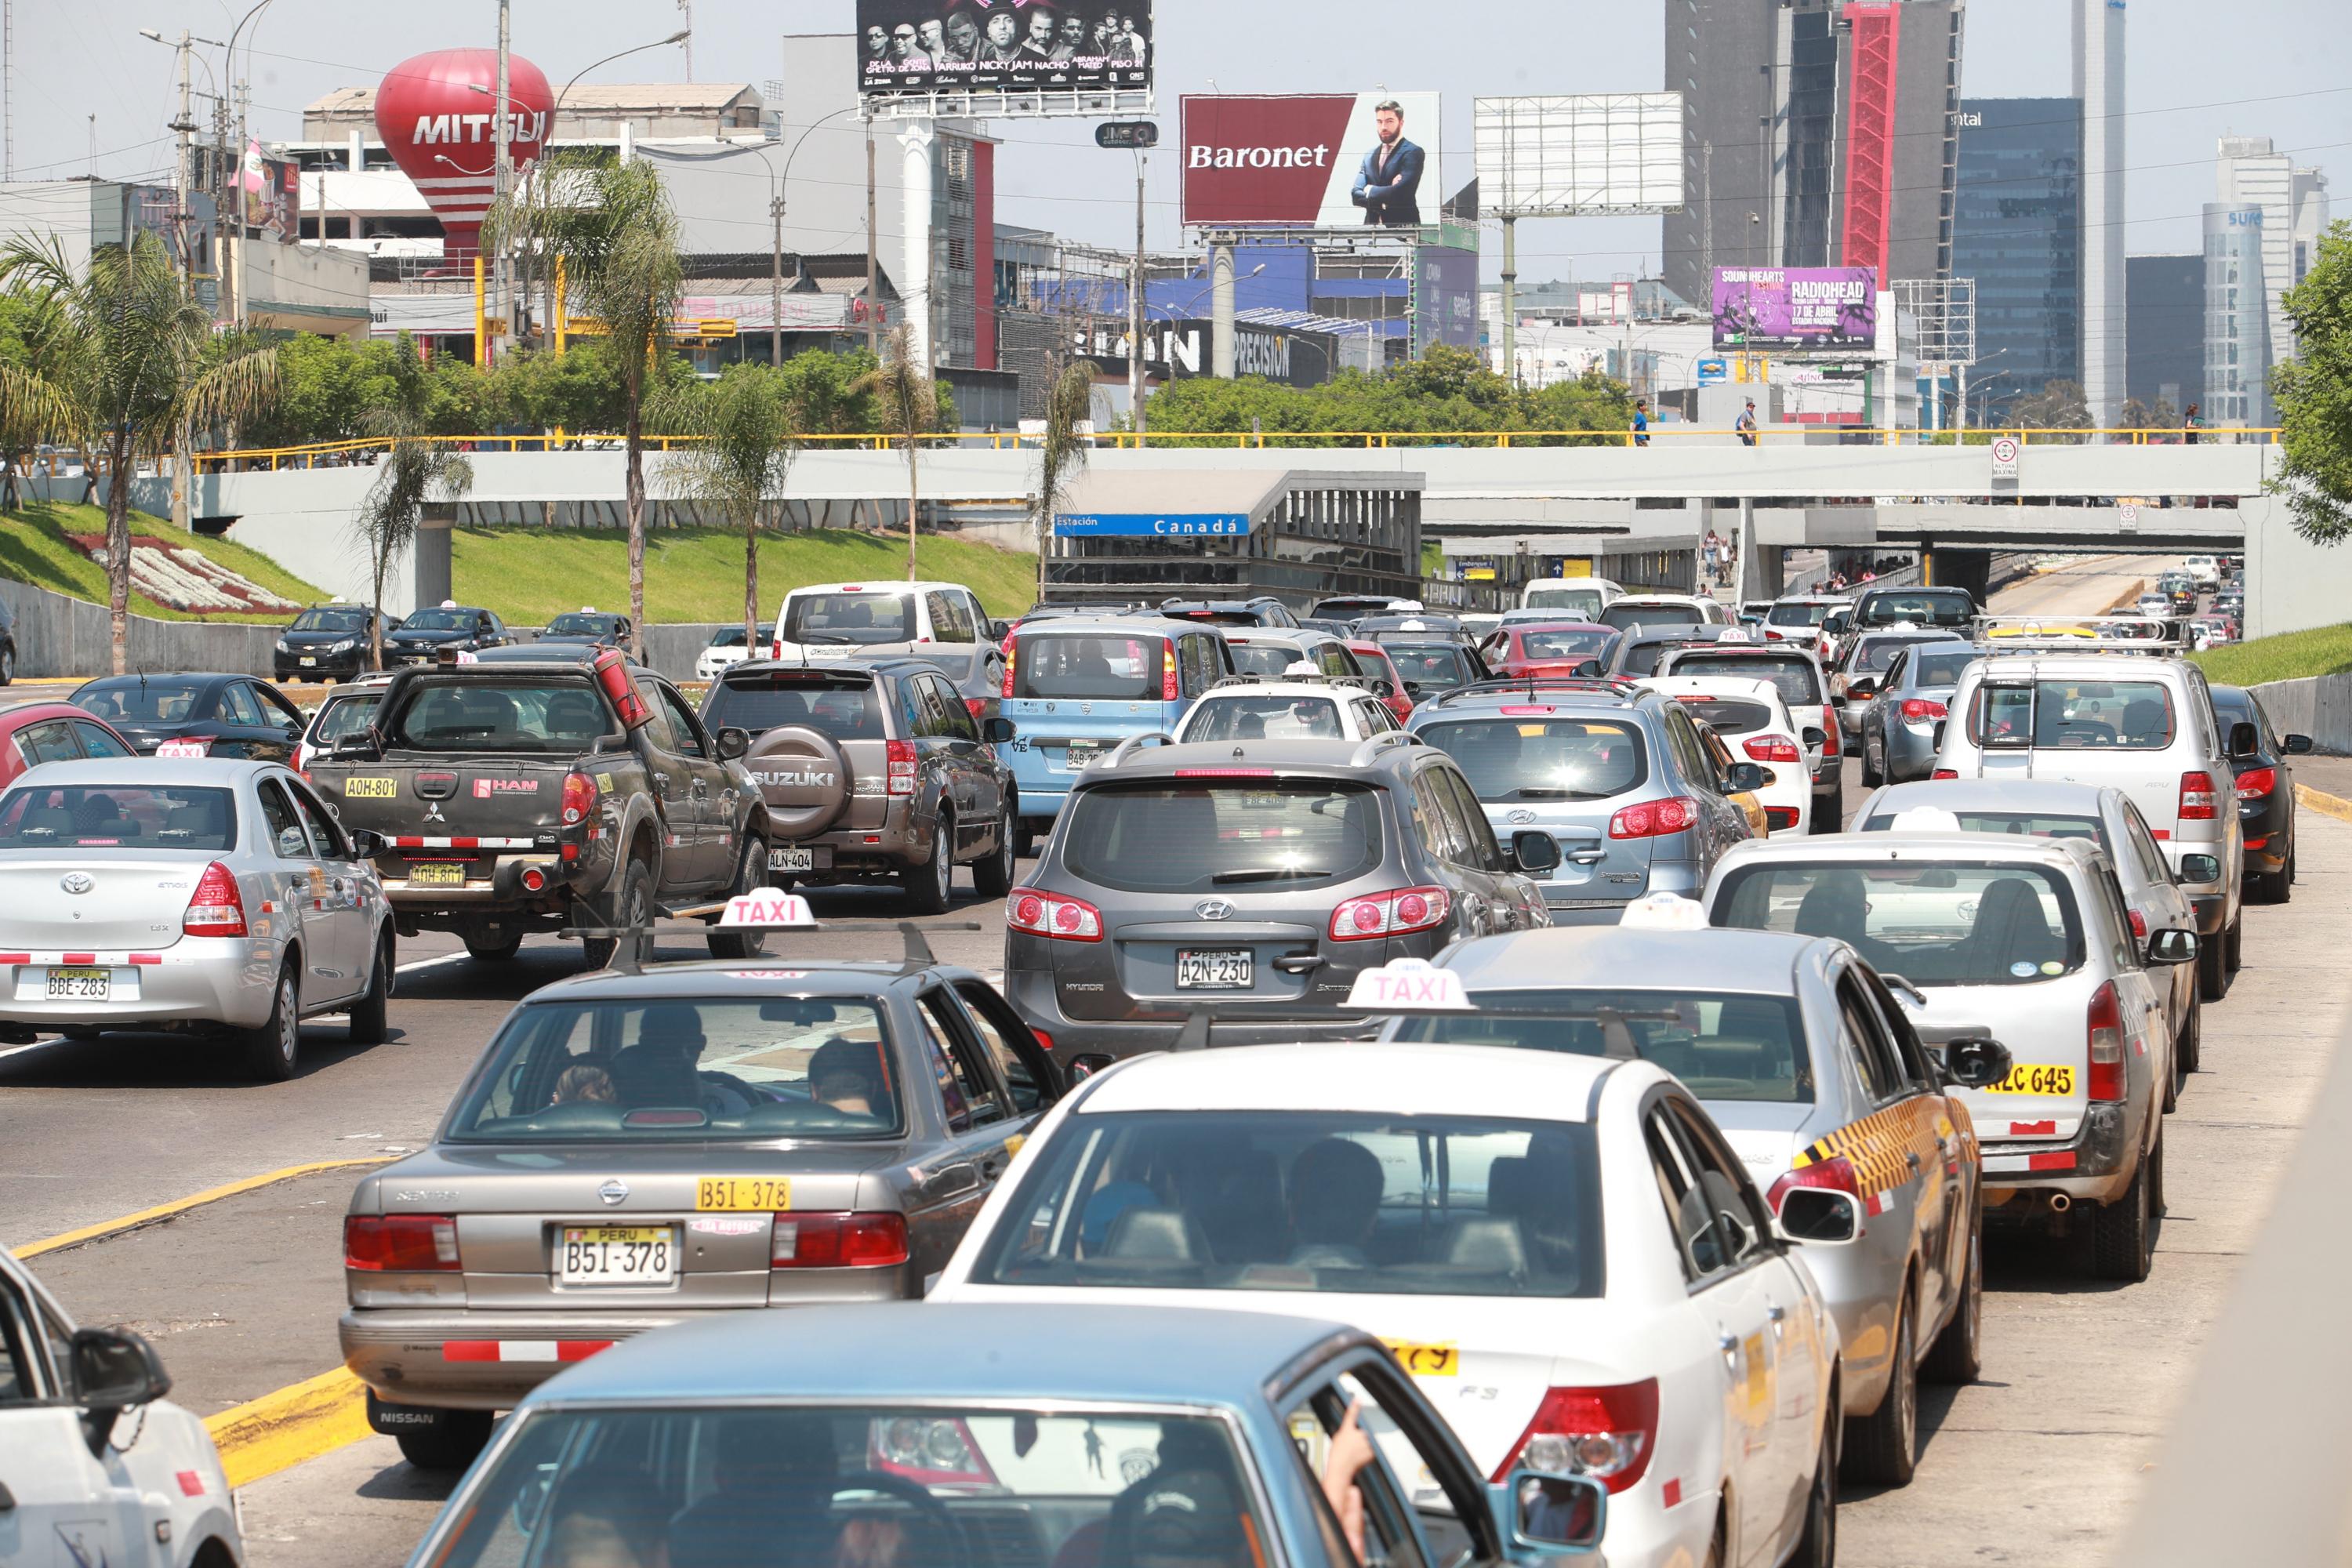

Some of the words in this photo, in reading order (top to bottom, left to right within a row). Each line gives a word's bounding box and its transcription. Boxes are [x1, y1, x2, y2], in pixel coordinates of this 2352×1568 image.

[866, 65, 895, 74] GHETTO
[934, 62, 977, 72] FARRUKO
[980, 60, 1009, 71] NICKY
[1010, 60, 1033, 71] JAM
[1035, 61, 1070, 71] NACHO
[1111, 60, 1133, 68] PISO
[412, 111, 546, 144] MITSUI
[1189, 144, 1329, 169] Baronet
[1791, 281, 1864, 298] RADIOHEAD
[1792, 306, 1802, 317] 17
[1803, 306, 1813, 317] DE
[1814, 306, 1838, 317] ABRIL
[1057, 516, 1098, 526] Estación
[1154, 518, 1237, 534] Canadá
[160, 748, 200, 757] TAXI
[492, 780, 539, 790] HAM
[750, 772, 835, 787] SUZUKI
[770, 854, 811, 868] ALN-404
[735, 900, 795, 923] TAXI
[1181, 960, 1249, 982] A2N-230
[49, 977, 107, 996] BBE-283
[1374, 977, 1447, 1002] TAXI
[598, 1229, 637, 1241] PERU
[380, 1413, 434, 1424] NISSAN
